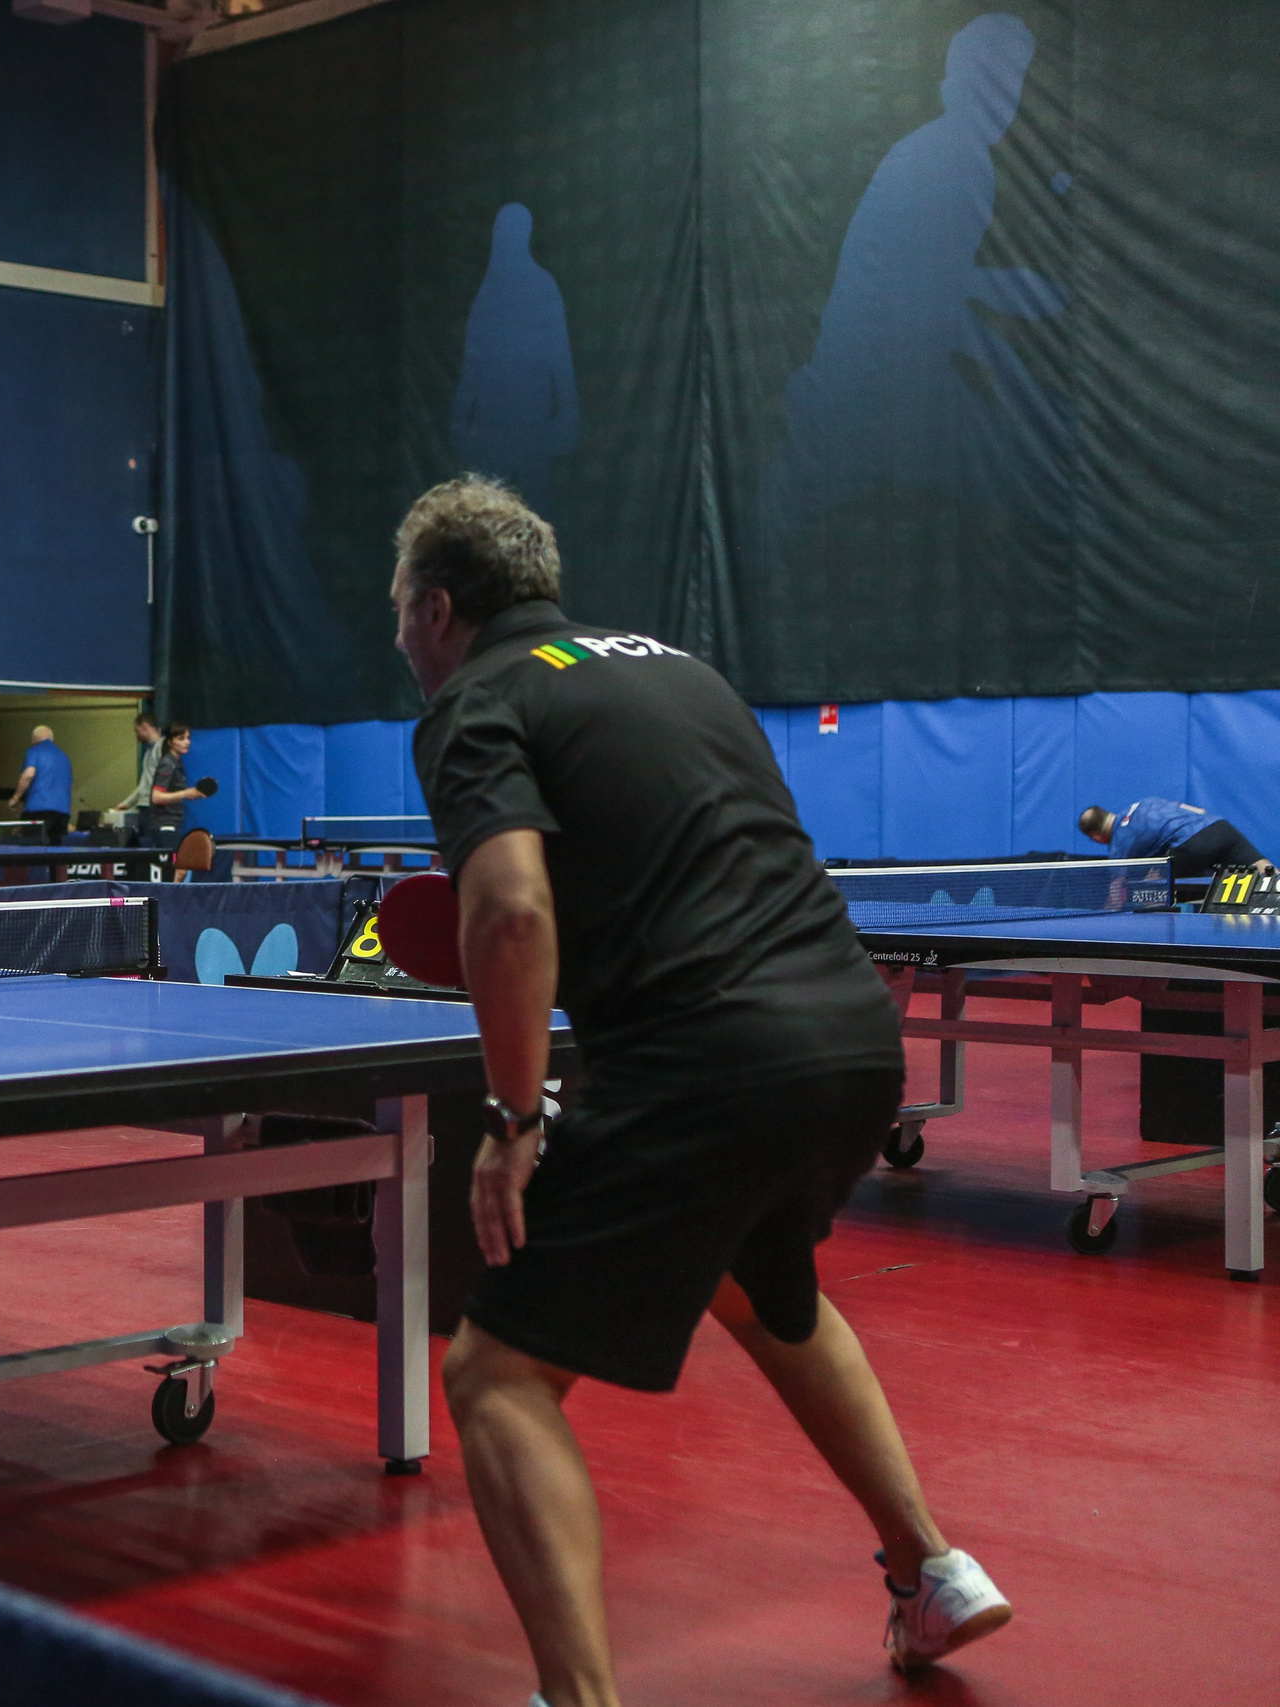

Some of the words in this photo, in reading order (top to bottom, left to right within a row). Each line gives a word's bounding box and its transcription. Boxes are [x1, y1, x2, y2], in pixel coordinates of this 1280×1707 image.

[1220, 874, 1253, 904] 11
[351, 916, 383, 958] 8
[867, 950, 909, 962] Centrefold
[910, 953, 921, 962] 25
